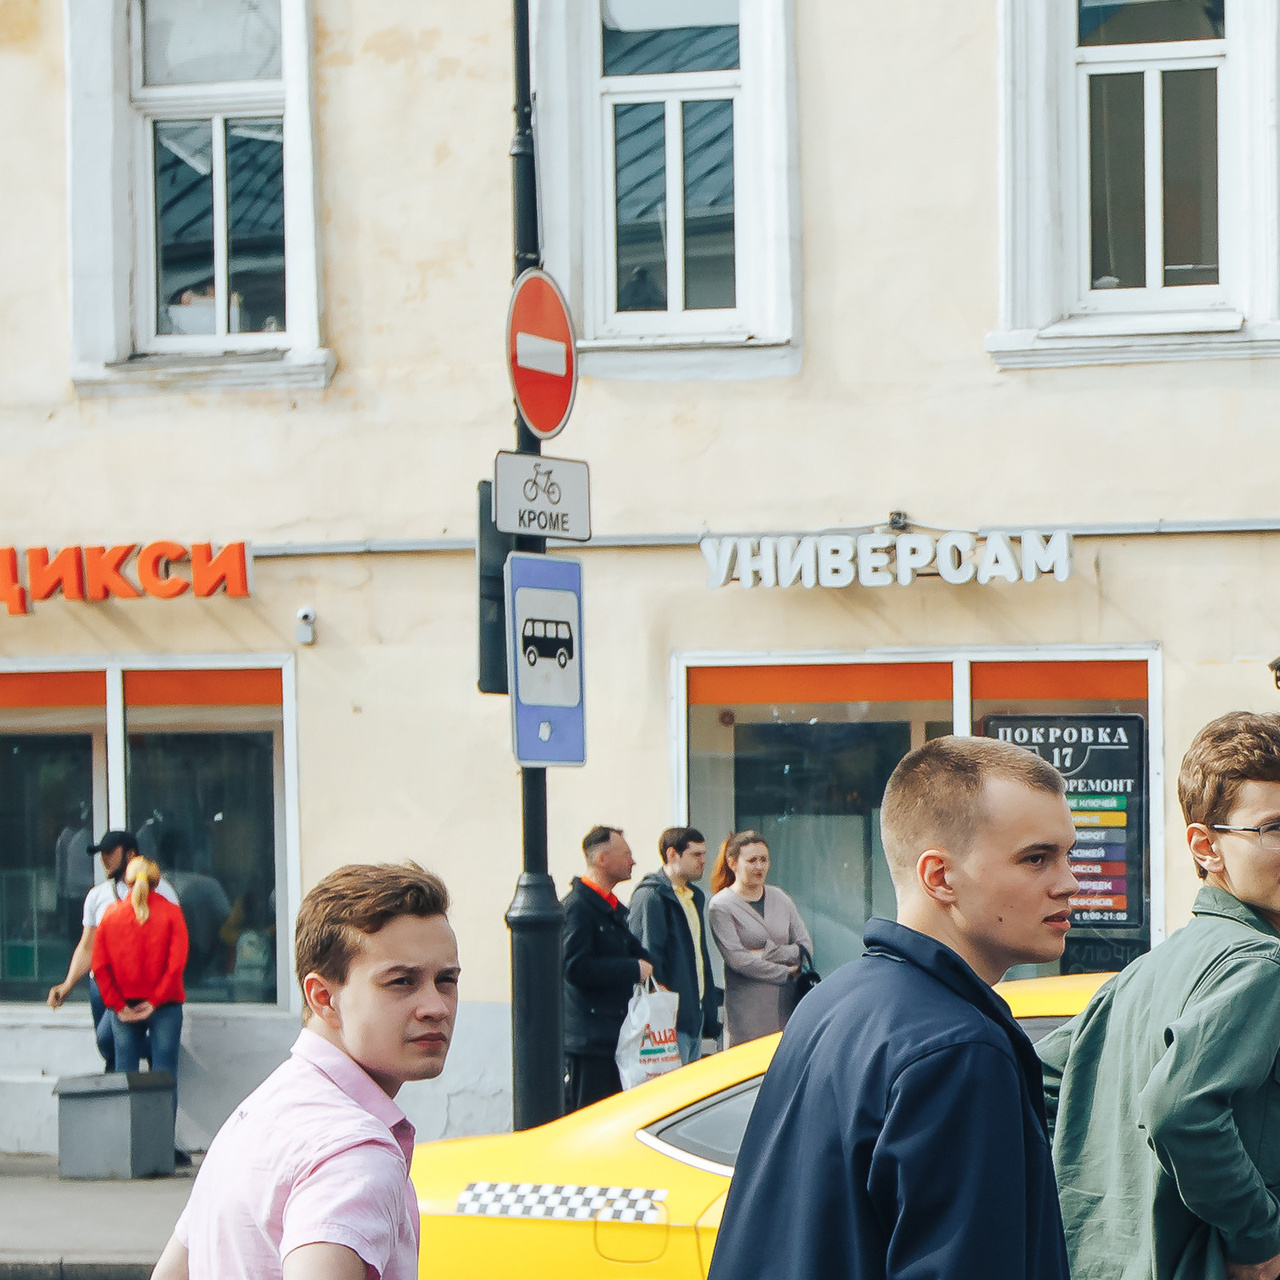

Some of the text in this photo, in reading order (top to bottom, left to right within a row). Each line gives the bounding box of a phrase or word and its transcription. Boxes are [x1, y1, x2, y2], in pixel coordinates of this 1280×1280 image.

[518, 508, 570, 532] КРОМЕ
[700, 529, 1074, 589] УНИВЕРСАМ
[998, 726, 1129, 745] ПОКРОВКА
[1051, 747, 1074, 768] 17
